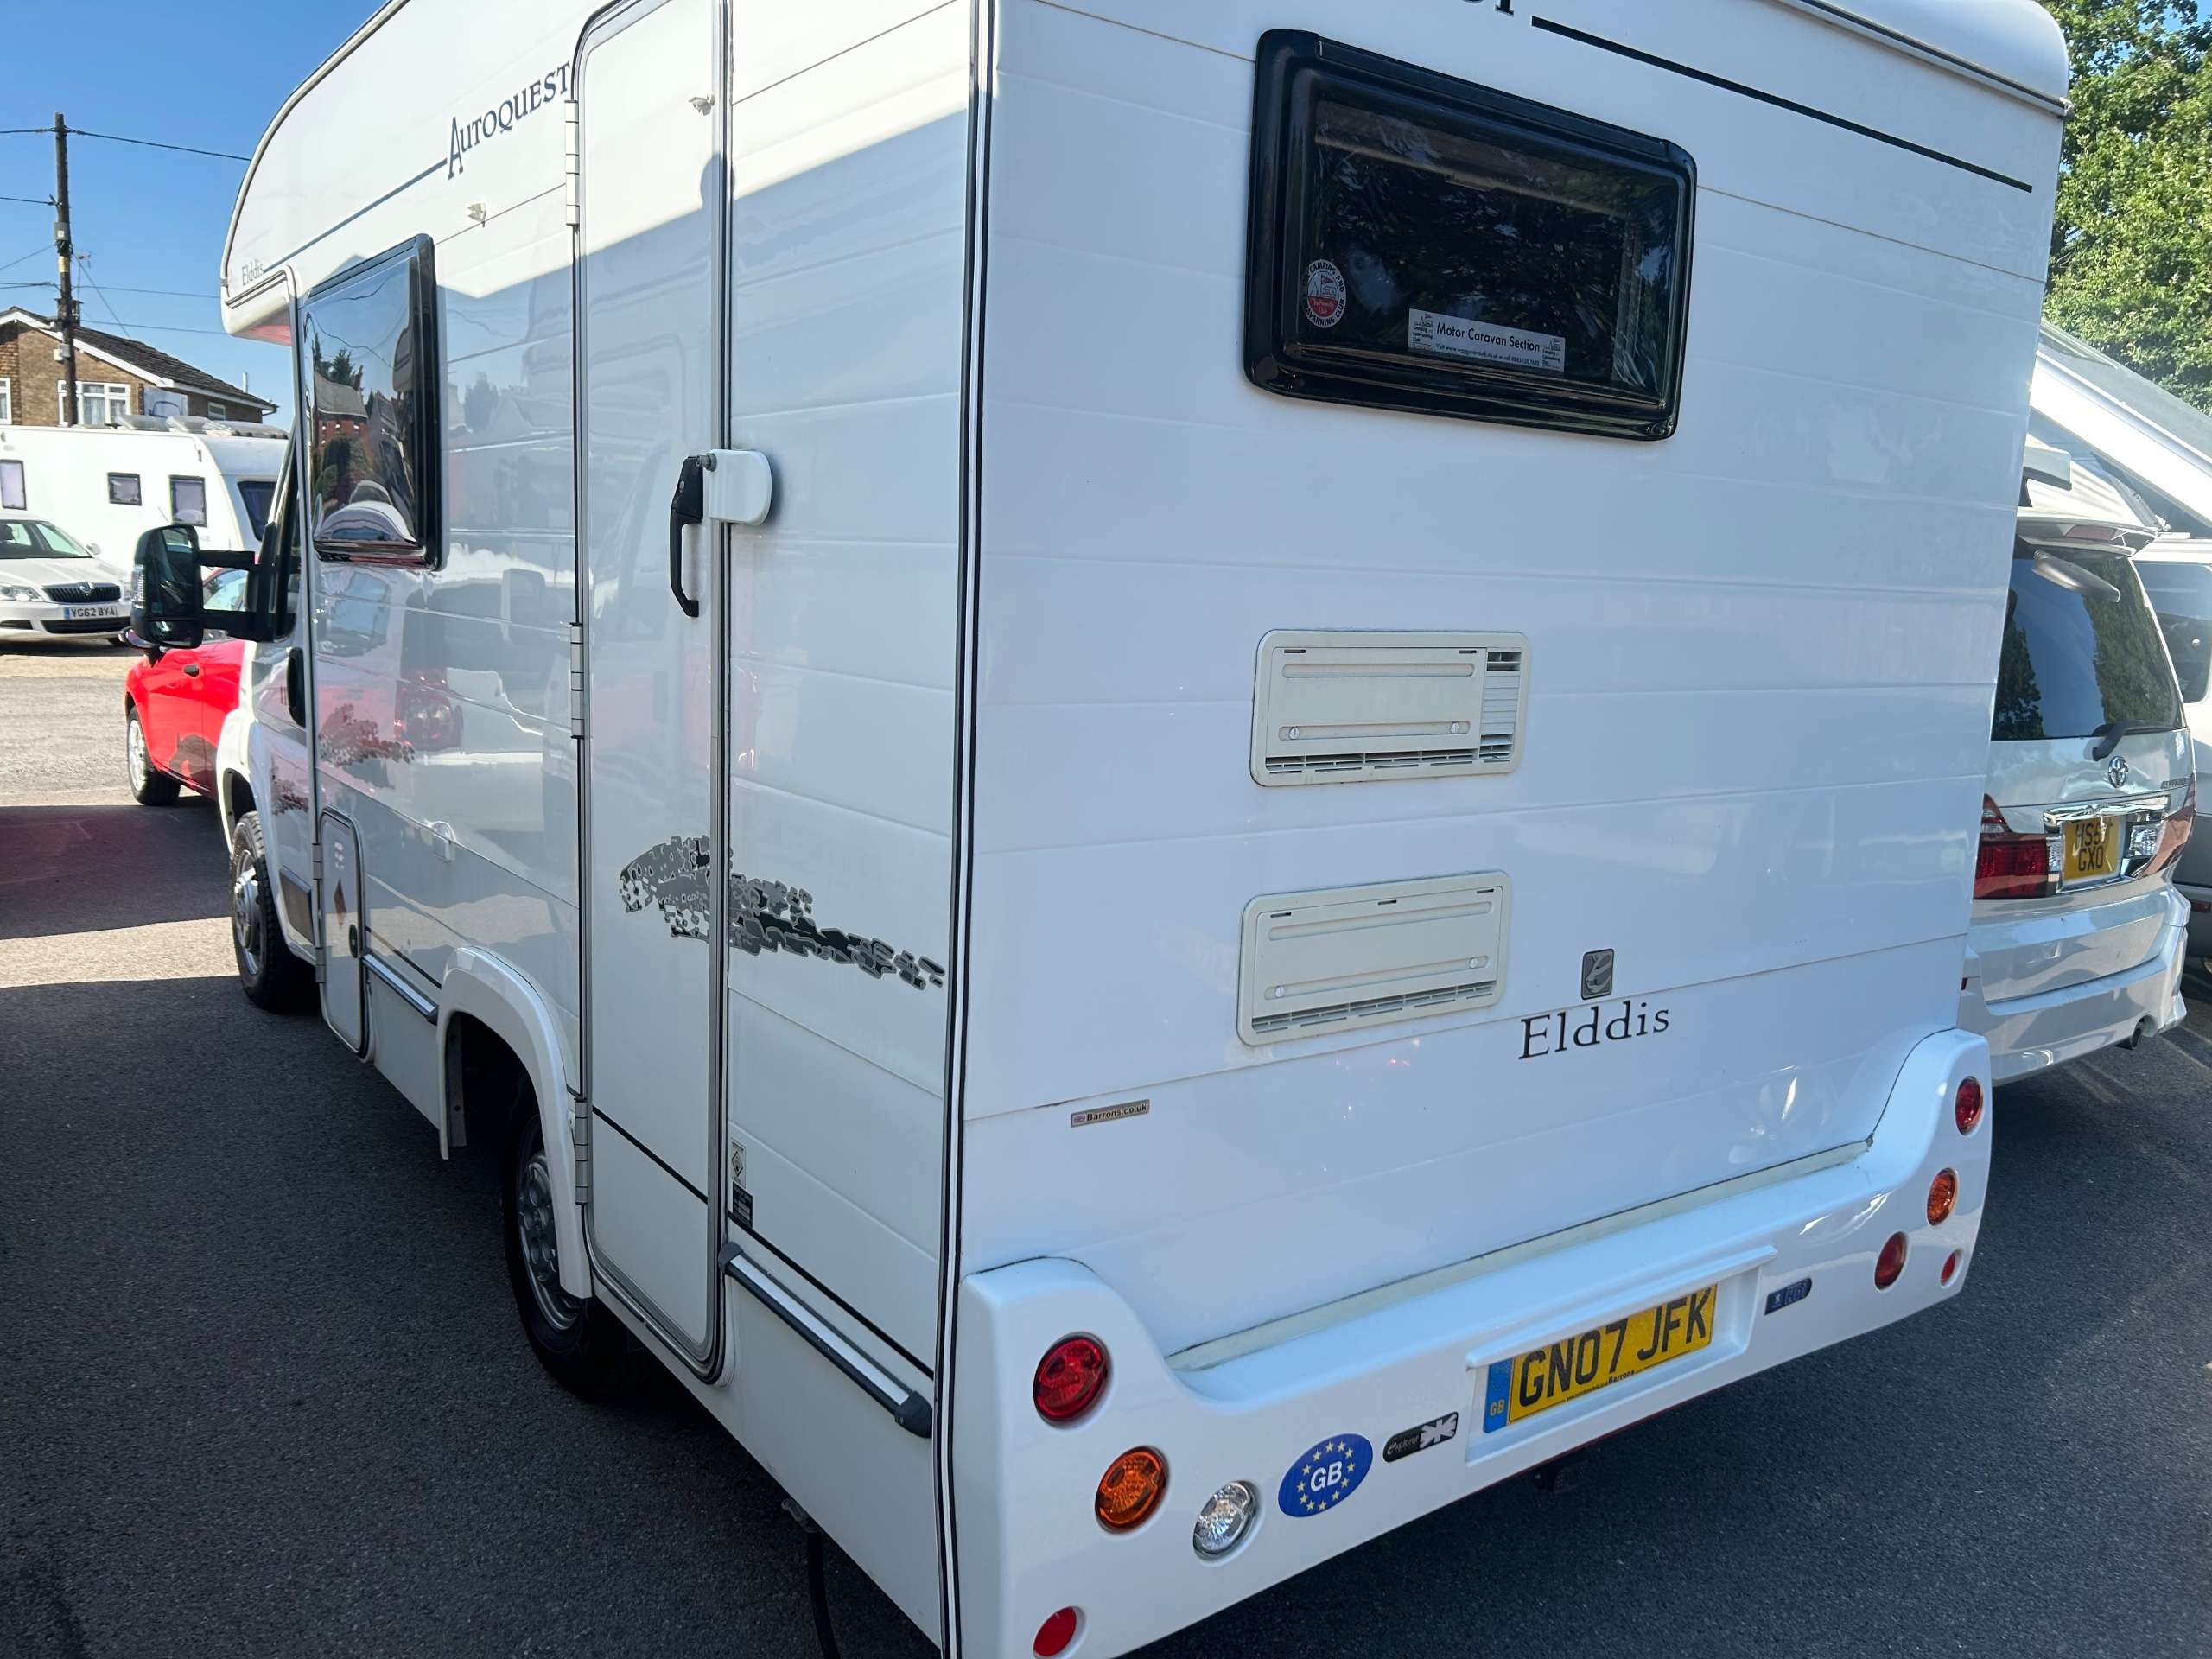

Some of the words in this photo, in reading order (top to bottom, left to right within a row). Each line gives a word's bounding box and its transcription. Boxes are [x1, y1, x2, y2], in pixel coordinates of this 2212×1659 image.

[1436, 321, 1465, 339] Motor
[1468, 328, 1507, 346] Caravan
[1509, 335, 1540, 353] Section
[71, 607, 96, 618] YG62
[98, 607, 115, 616] BYA
[1518, 1000, 1669, 1059] Elddis
[1086, 1103, 1147, 1122] Barrons.co.uk
[1518, 1318, 1630, 1408] GN07
[1637, 1282, 1712, 1362] JFK
[1491, 1399, 1504, 1416] GB
[1310, 1460, 1343, 1492] GB
